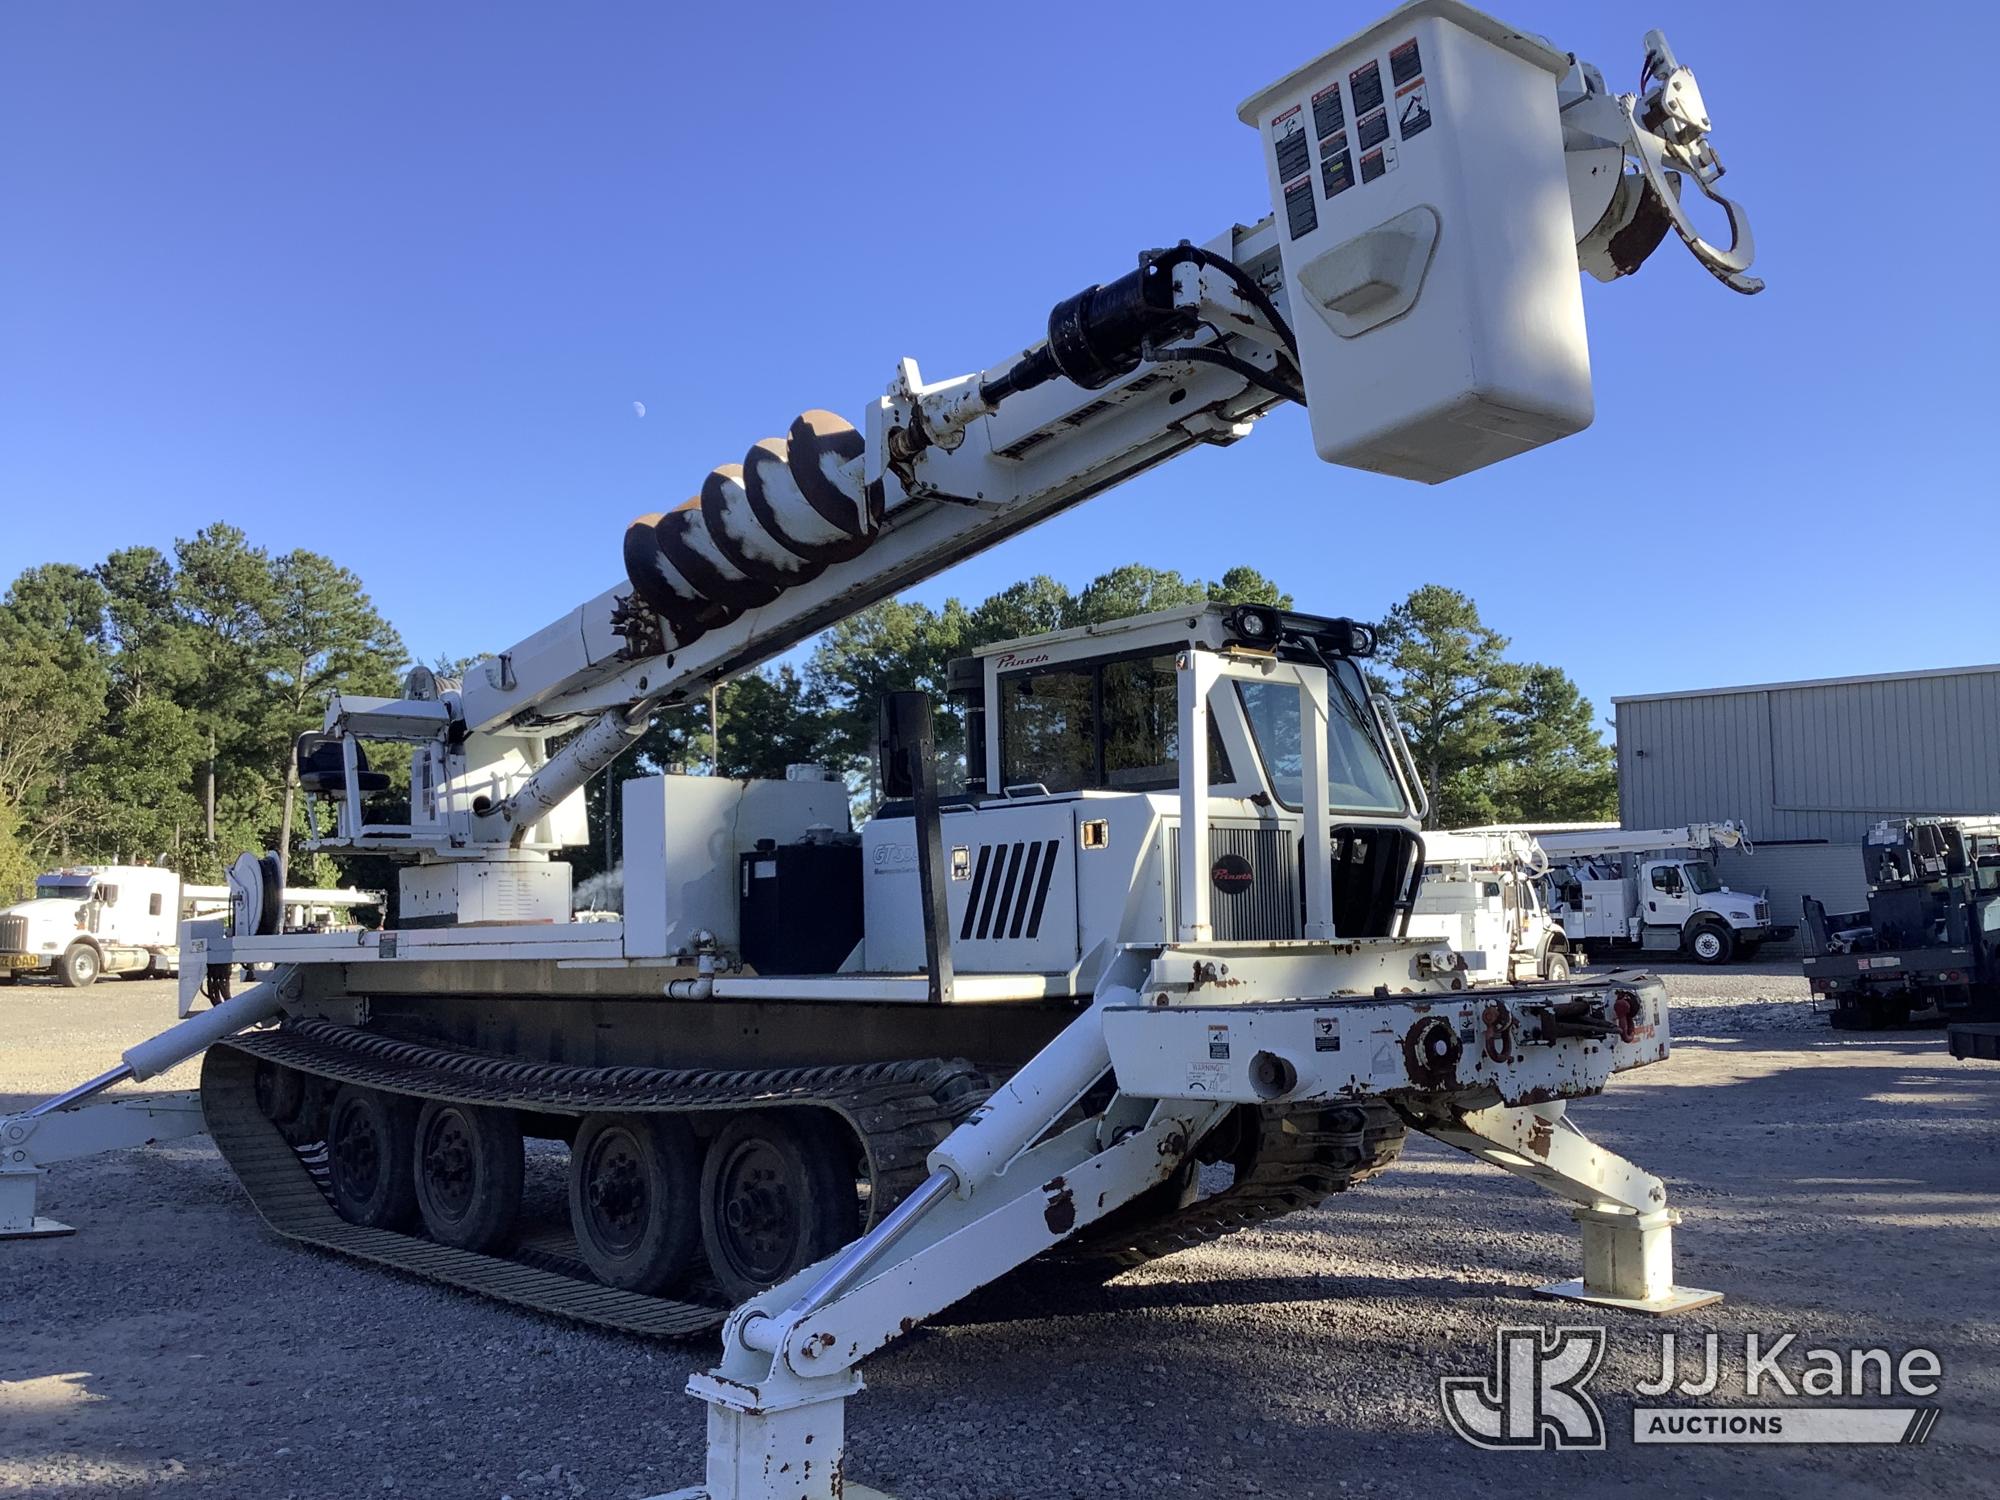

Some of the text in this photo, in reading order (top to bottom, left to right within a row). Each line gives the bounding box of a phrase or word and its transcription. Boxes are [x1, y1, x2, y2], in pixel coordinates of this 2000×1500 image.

[995, 654, 1049, 669] Prinoth
[1212, 868, 1253, 880] Prinoth
[11, 954, 37, 967] LOAD
